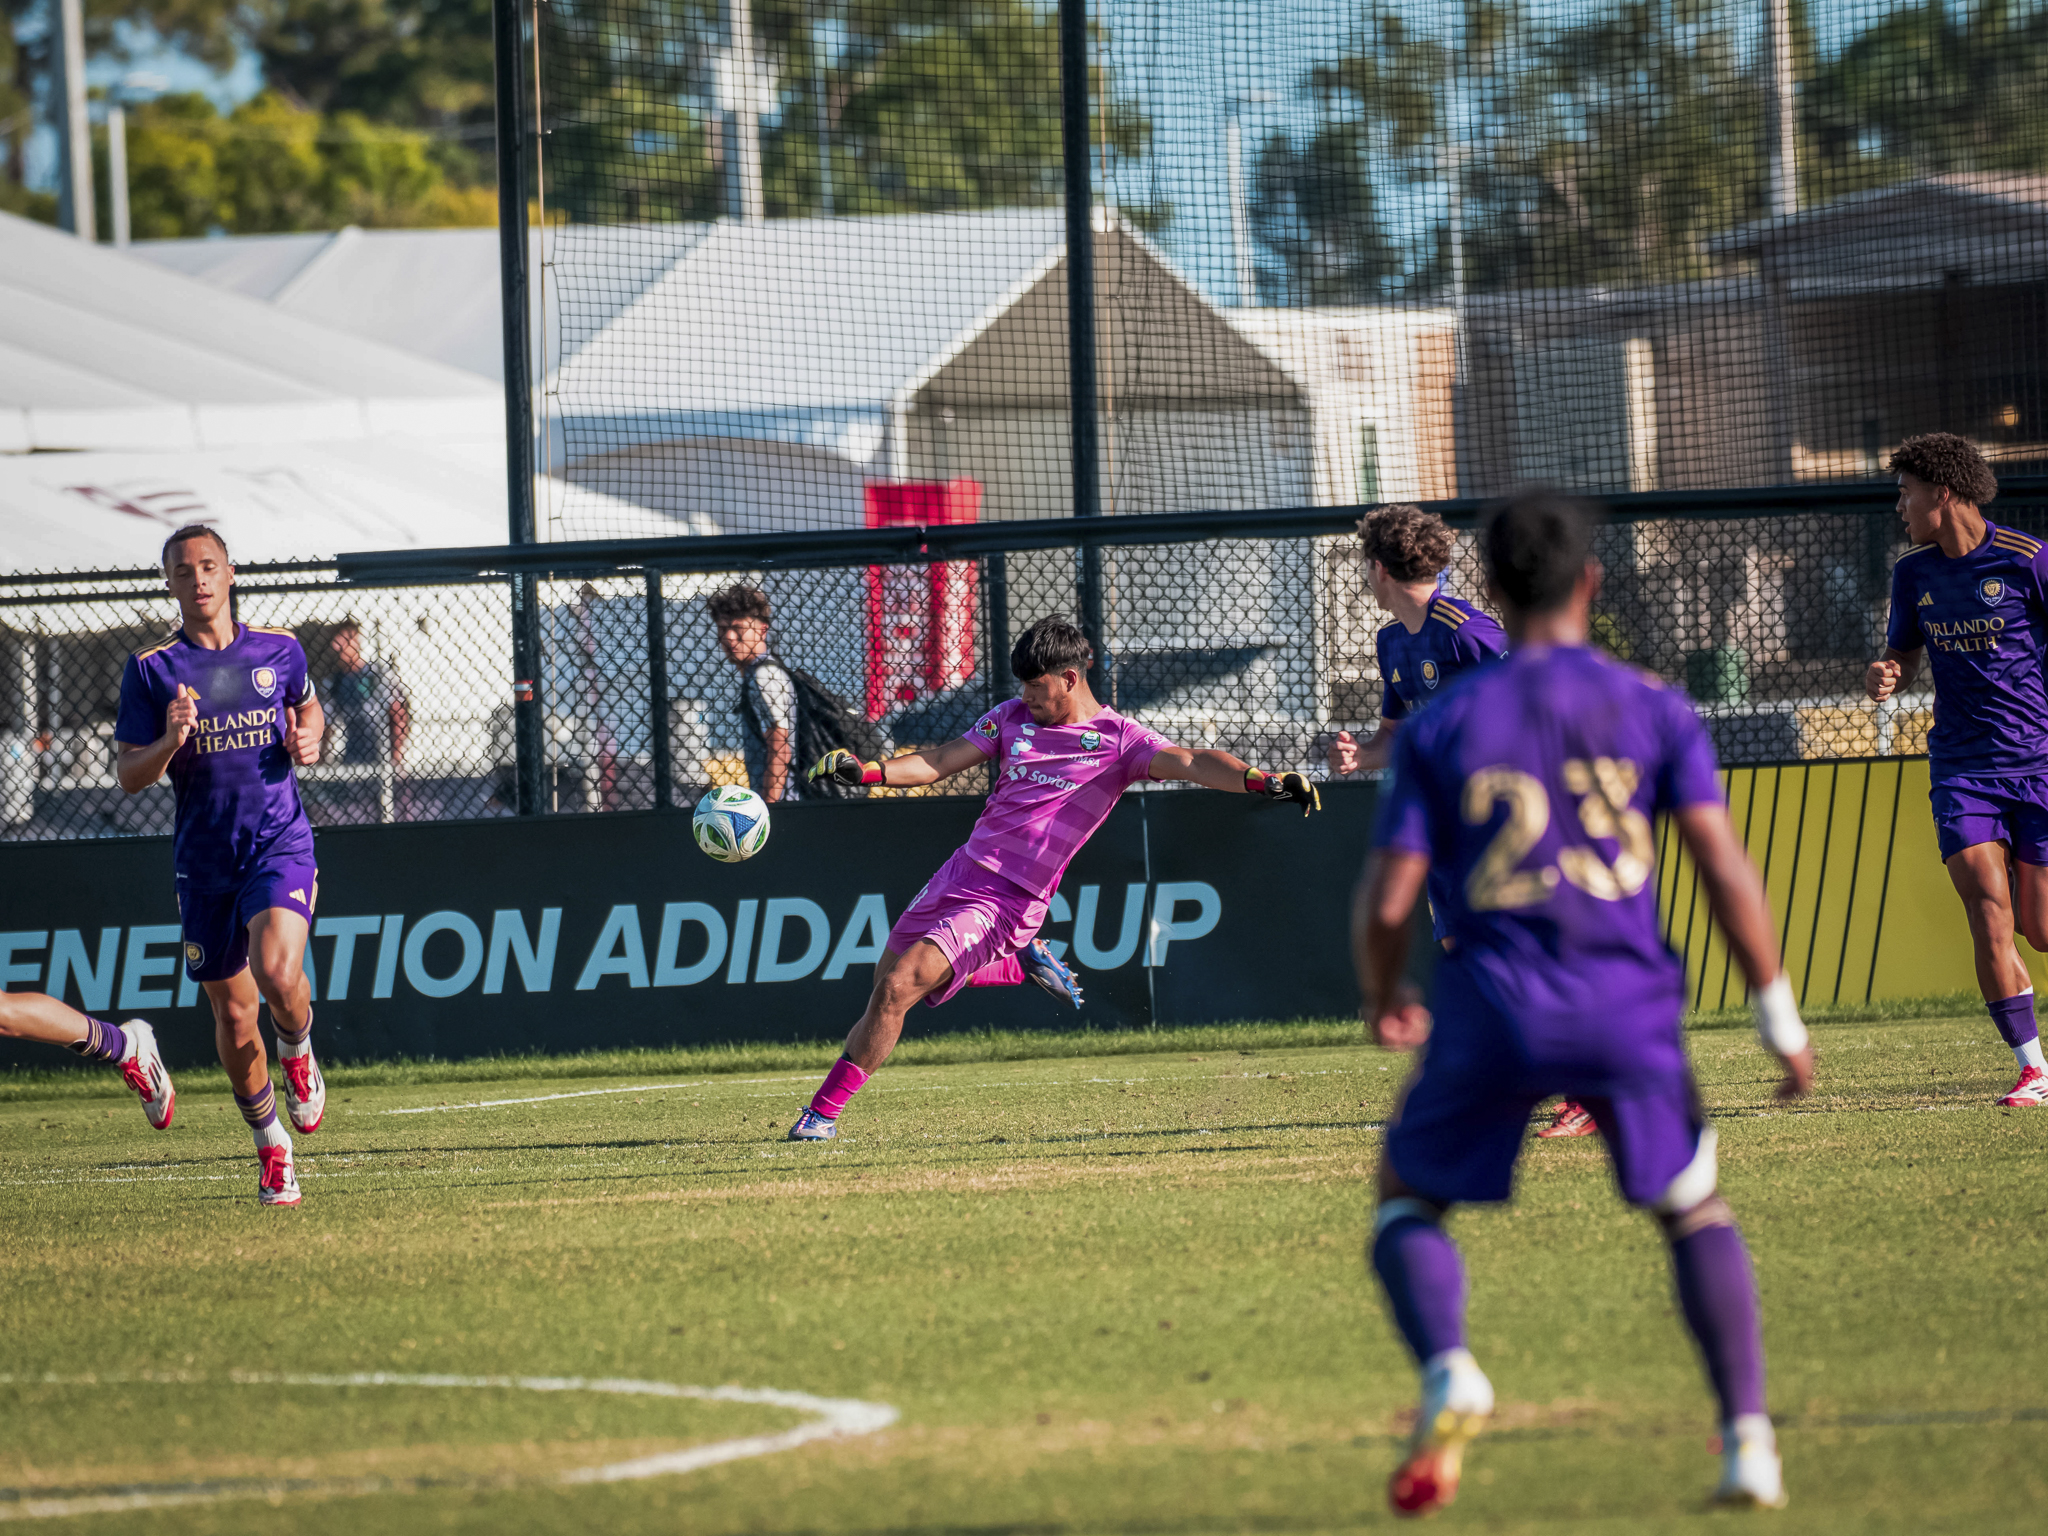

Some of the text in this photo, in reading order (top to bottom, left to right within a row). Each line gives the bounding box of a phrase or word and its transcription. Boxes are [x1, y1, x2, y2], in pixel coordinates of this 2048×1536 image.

[1924, 616, 2005, 636] ORLANDO
[188, 707, 277, 737] RLANDO
[195, 728, 273, 755] HEALTH
[1028, 770, 1083, 791] Sorian
[1460, 756, 1655, 913] 23
[0, 907, 562, 1011] ENETION
[575, 893, 891, 990] ADIDA
